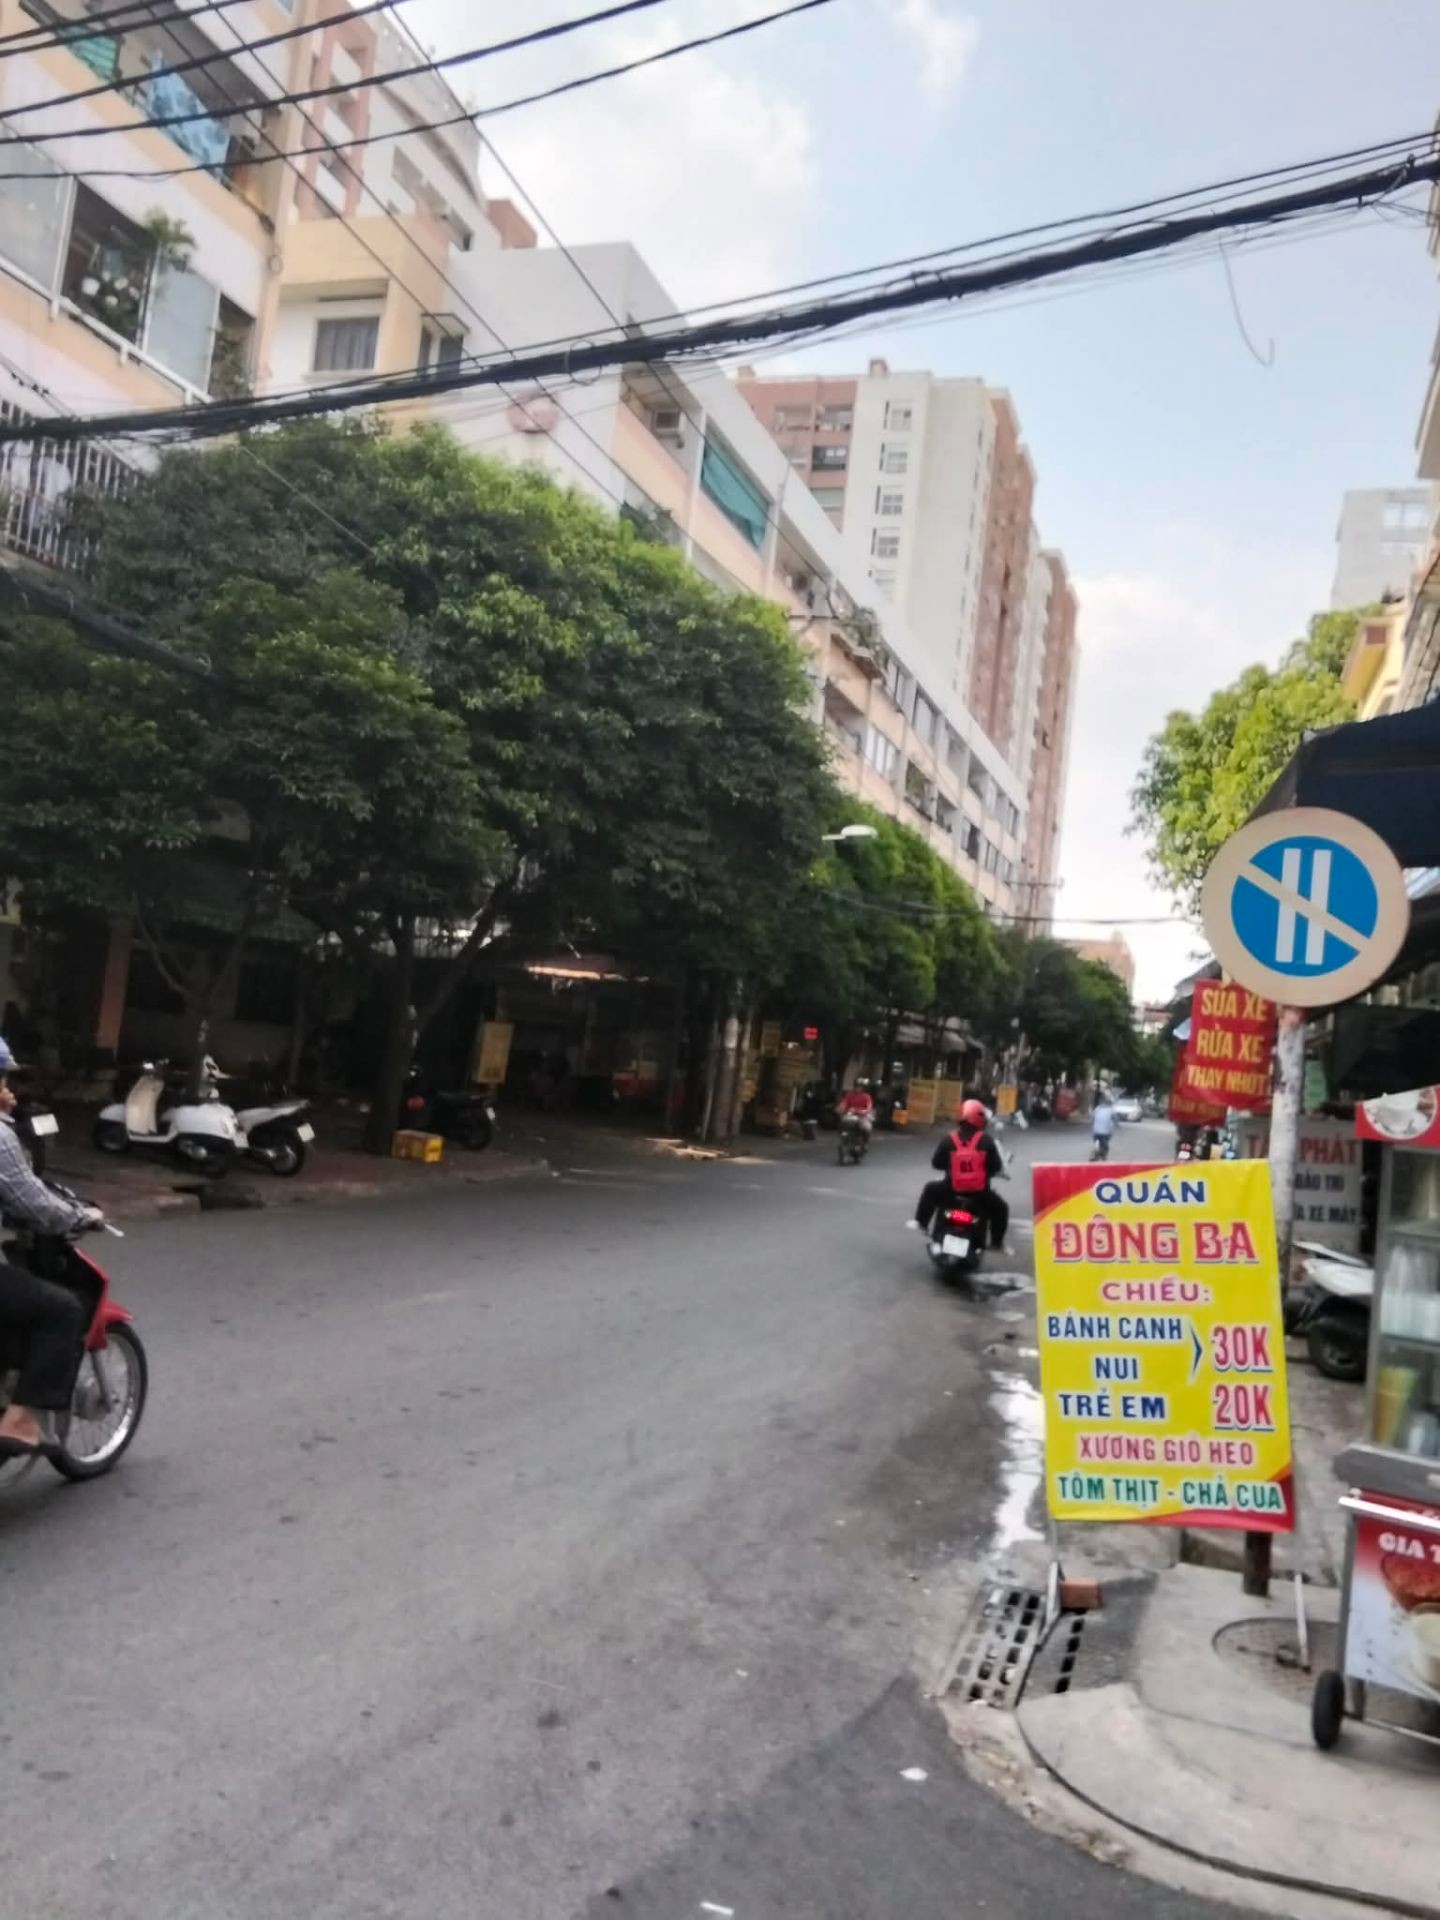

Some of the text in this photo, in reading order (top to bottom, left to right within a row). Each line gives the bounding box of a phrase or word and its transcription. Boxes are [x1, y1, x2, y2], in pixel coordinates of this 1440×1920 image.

[1242, 992, 1268, 1020] XE
[1196, 1023, 1264, 1063] RỬA XE
[1187, 1065, 1222, 1089] THAY
[1094, 1174, 1206, 1204] QUÁN
[1053, 1215, 1258, 1262] ĐÔNG BA
[1047, 1311, 1182, 1340] BÁNH CANH
[1212, 1326, 1273, 1373] 30K
[1095, 1357, 1138, 1379] NUI
[1058, 1387, 1165, 1418] TRẺ EM
[1213, 1384, 1274, 1430] 20K
[1080, 1436, 1156, 1462] XƯƠNG
[1210, 1441, 1254, 1465] HEO
[1057, 1471, 1105, 1500] TÔM
[1112, 1479, 1160, 1508] THỊT
[1182, 1475, 1228, 1507] CHẢ
[1236, 1485, 1283, 1509] CUA
[1378, 1531, 1425, 1559] GIA
